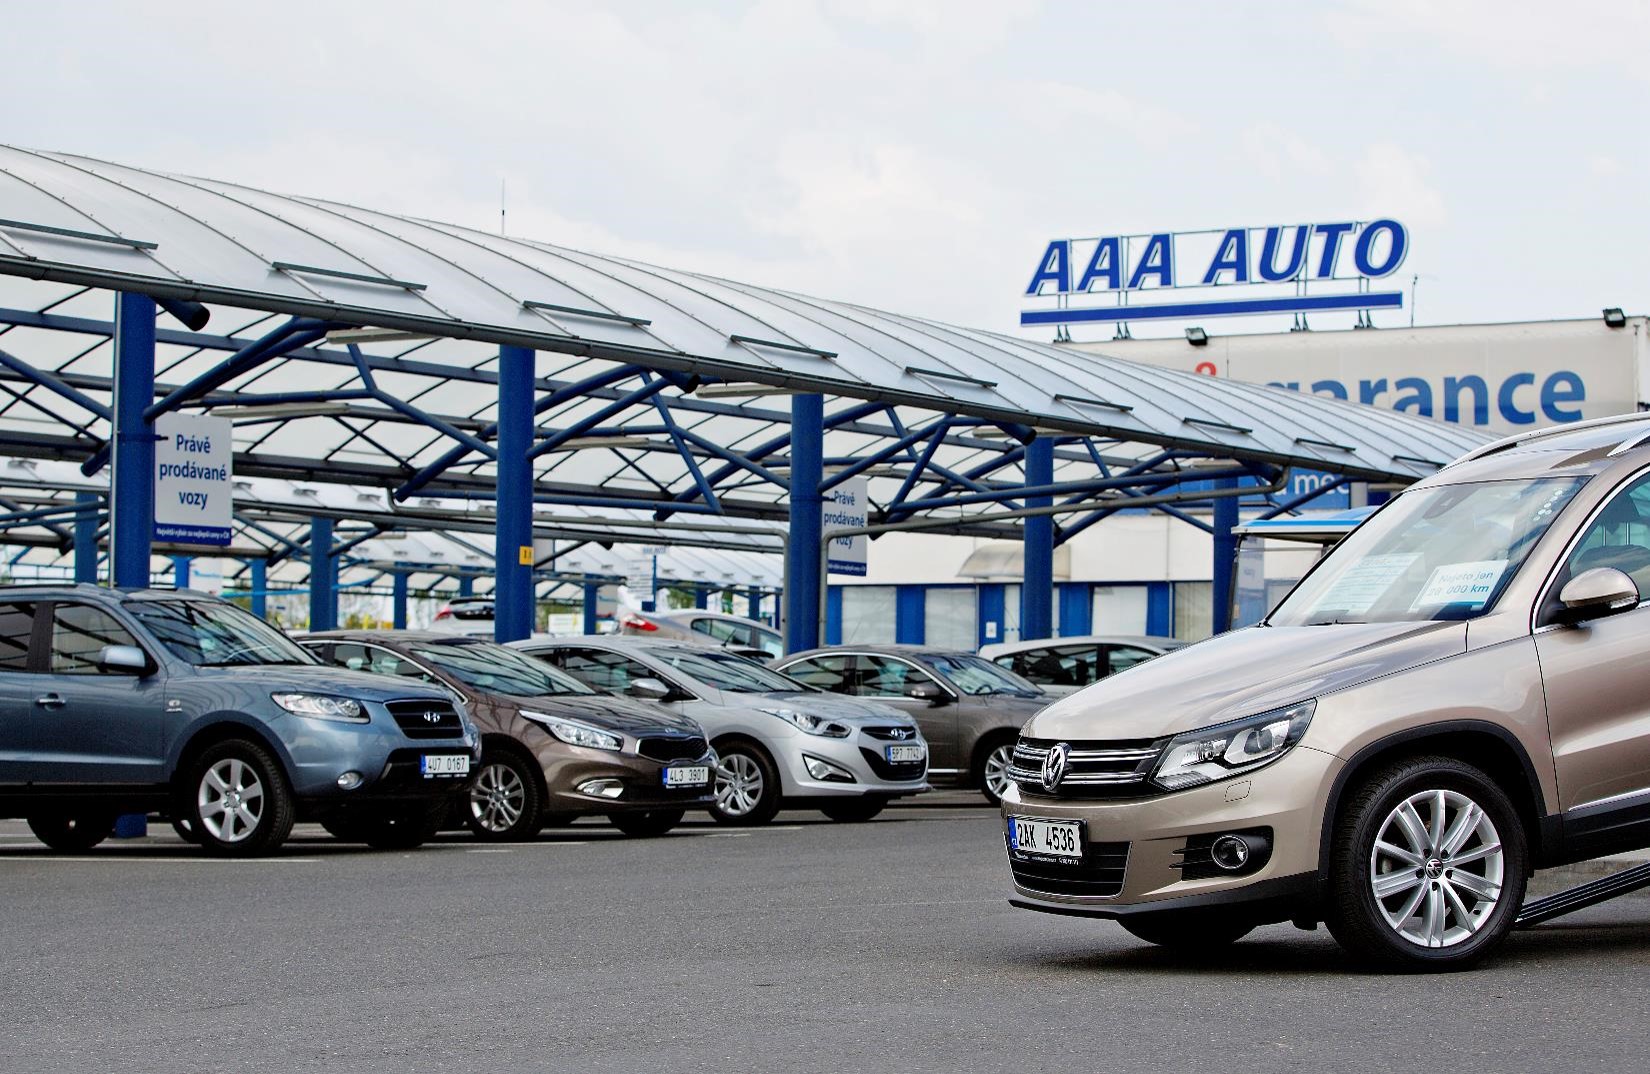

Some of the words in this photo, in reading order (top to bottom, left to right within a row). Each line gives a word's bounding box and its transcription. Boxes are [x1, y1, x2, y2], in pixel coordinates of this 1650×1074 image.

[1025, 233, 1174, 296] AAA
[1201, 218, 1409, 285] AUTO
[1265, 370, 1586, 426] rance
[176, 433, 211, 454] Právě
[159, 460, 227, 481] prodávané
[179, 491, 208, 510] vozy
[834, 490, 855, 505] Právě
[824, 511, 864, 527] prodávané
[1470, 584, 1490, 593] km
[1017, 823, 1037, 849] 2AK
[1045, 826, 1075, 852] 4536
